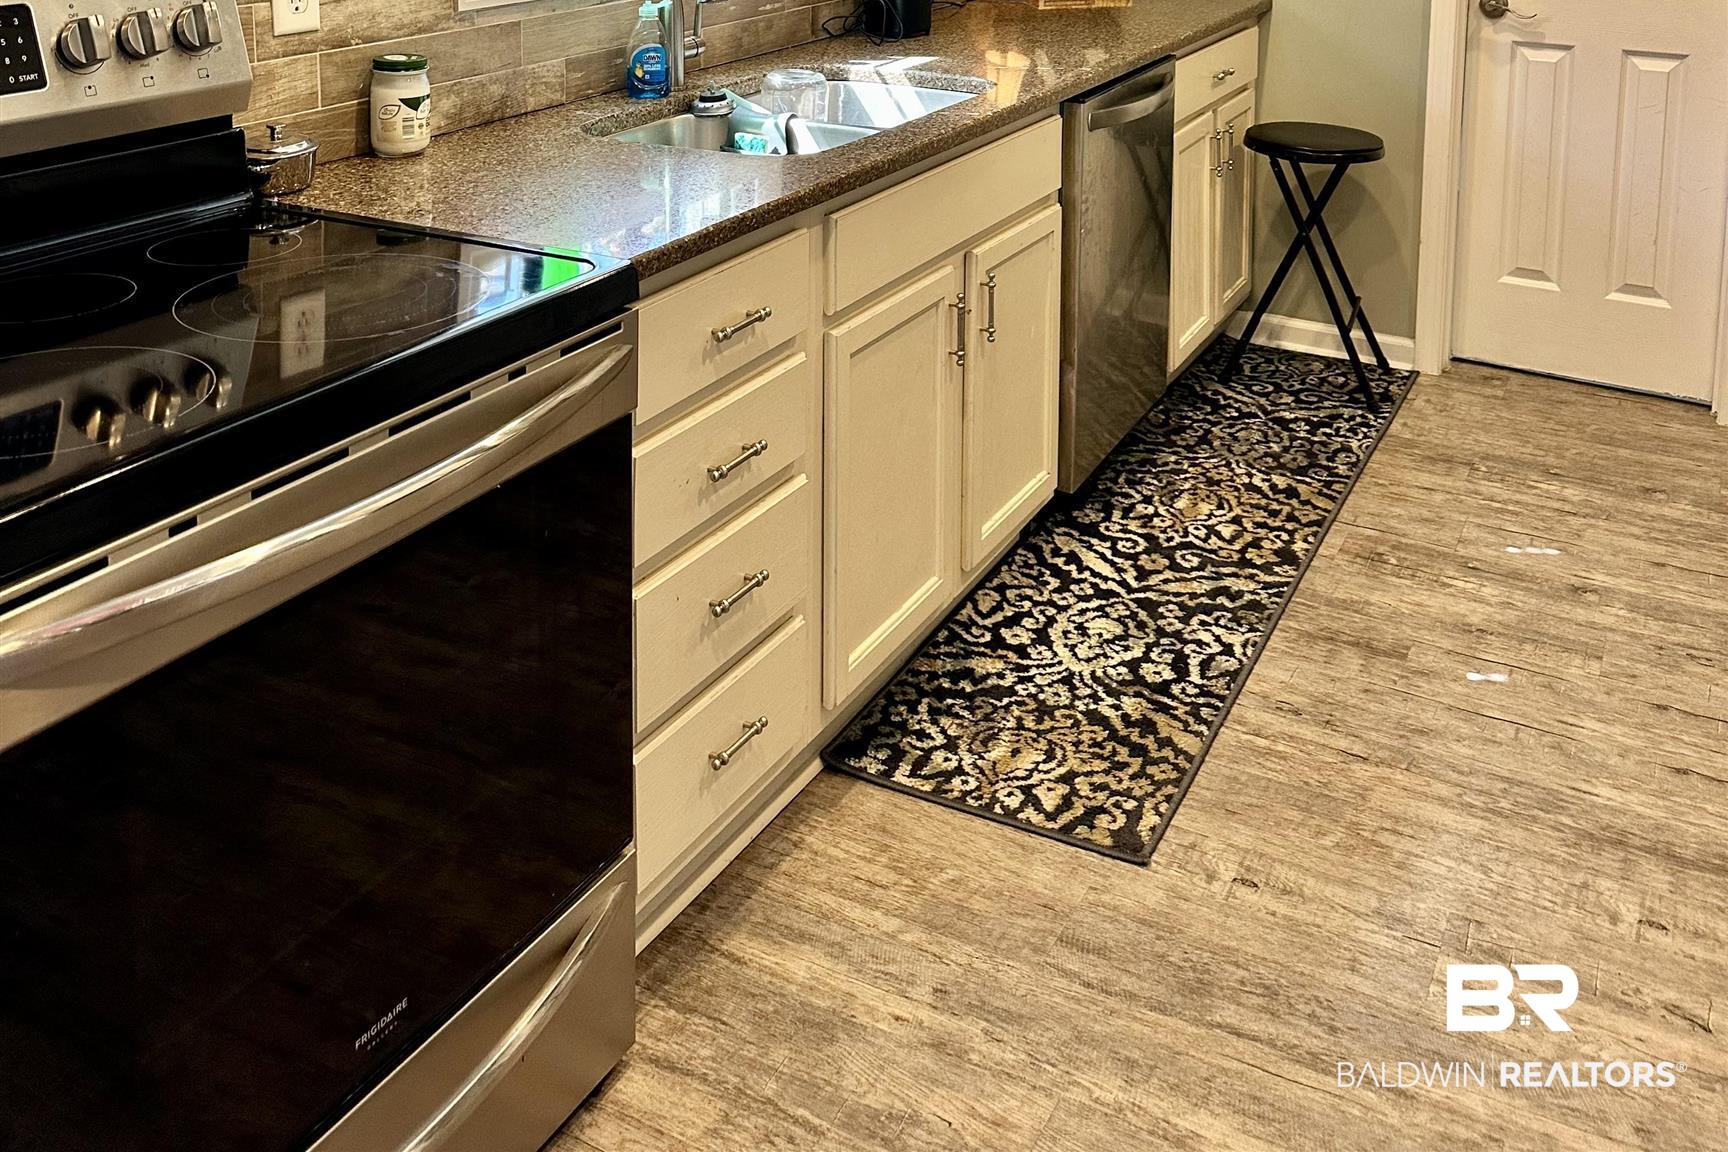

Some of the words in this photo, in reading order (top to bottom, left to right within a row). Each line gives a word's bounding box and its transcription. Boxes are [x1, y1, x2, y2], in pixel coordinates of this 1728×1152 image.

[0, 38, 6, 46] 5
[4, 57, 11, 65] 8
[18, 73, 39, 82] START
[355, 996, 408, 1051] FRIGIDAIRE
